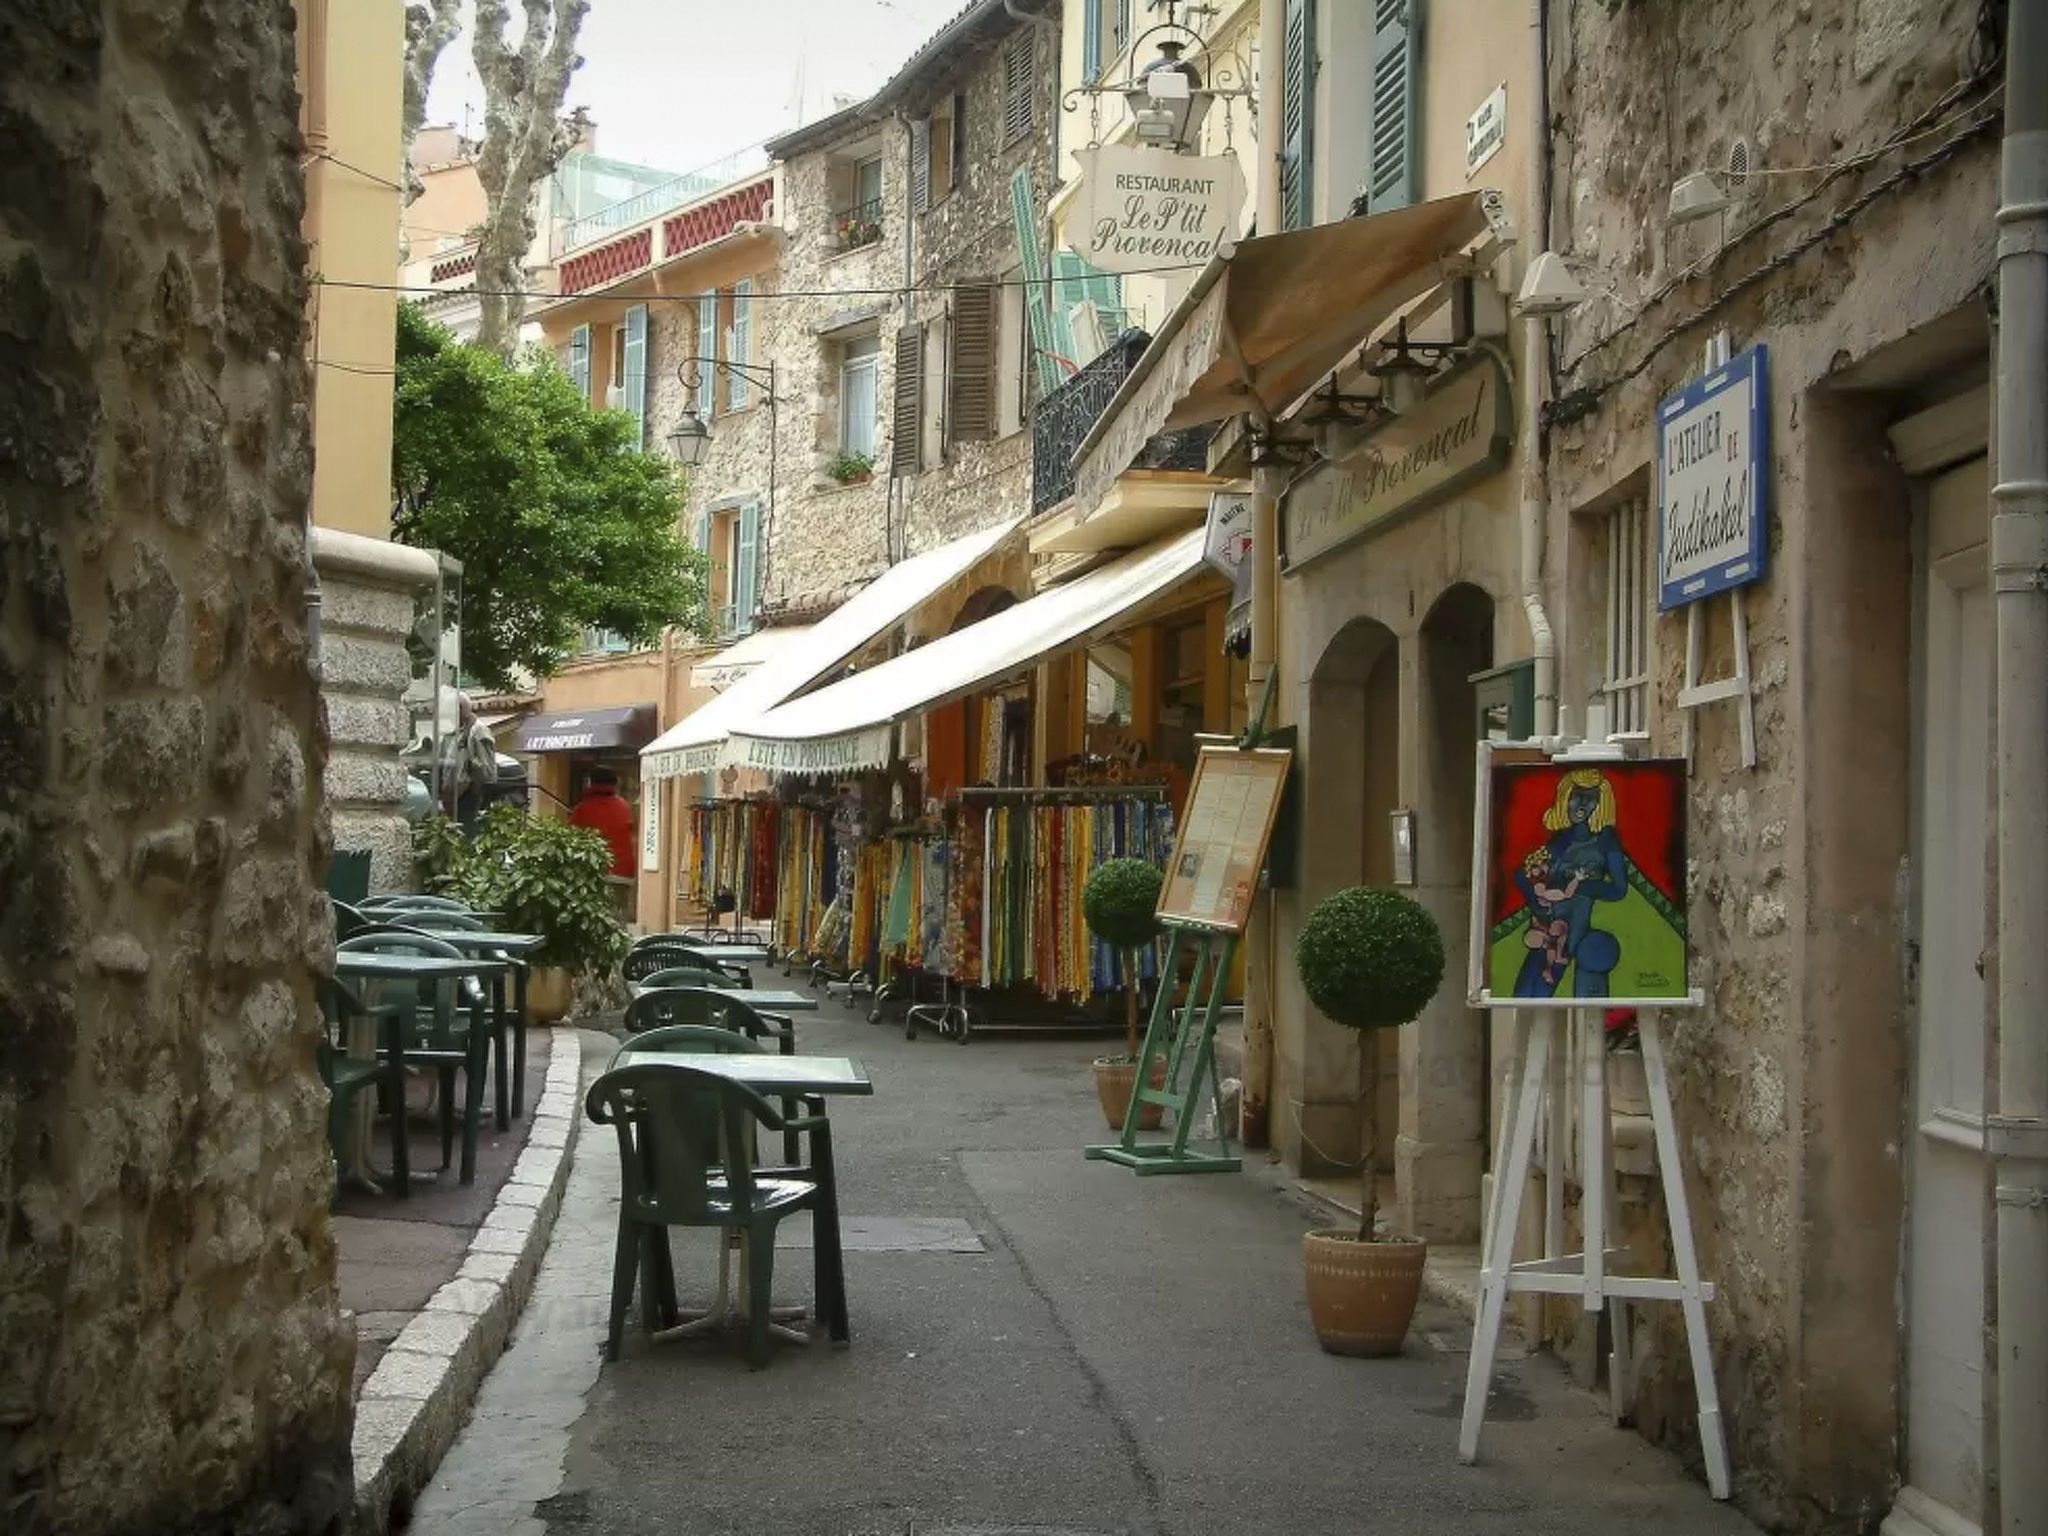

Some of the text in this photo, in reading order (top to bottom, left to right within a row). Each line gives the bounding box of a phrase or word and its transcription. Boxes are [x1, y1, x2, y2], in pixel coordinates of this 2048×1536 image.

[1115, 174, 1215, 196] RESTAURANT
[1121, 195, 1208, 234] Le P'tit
[1091, 217, 1226, 264] Provençal
[1669, 410, 1738, 476] L'ATELIER DE
